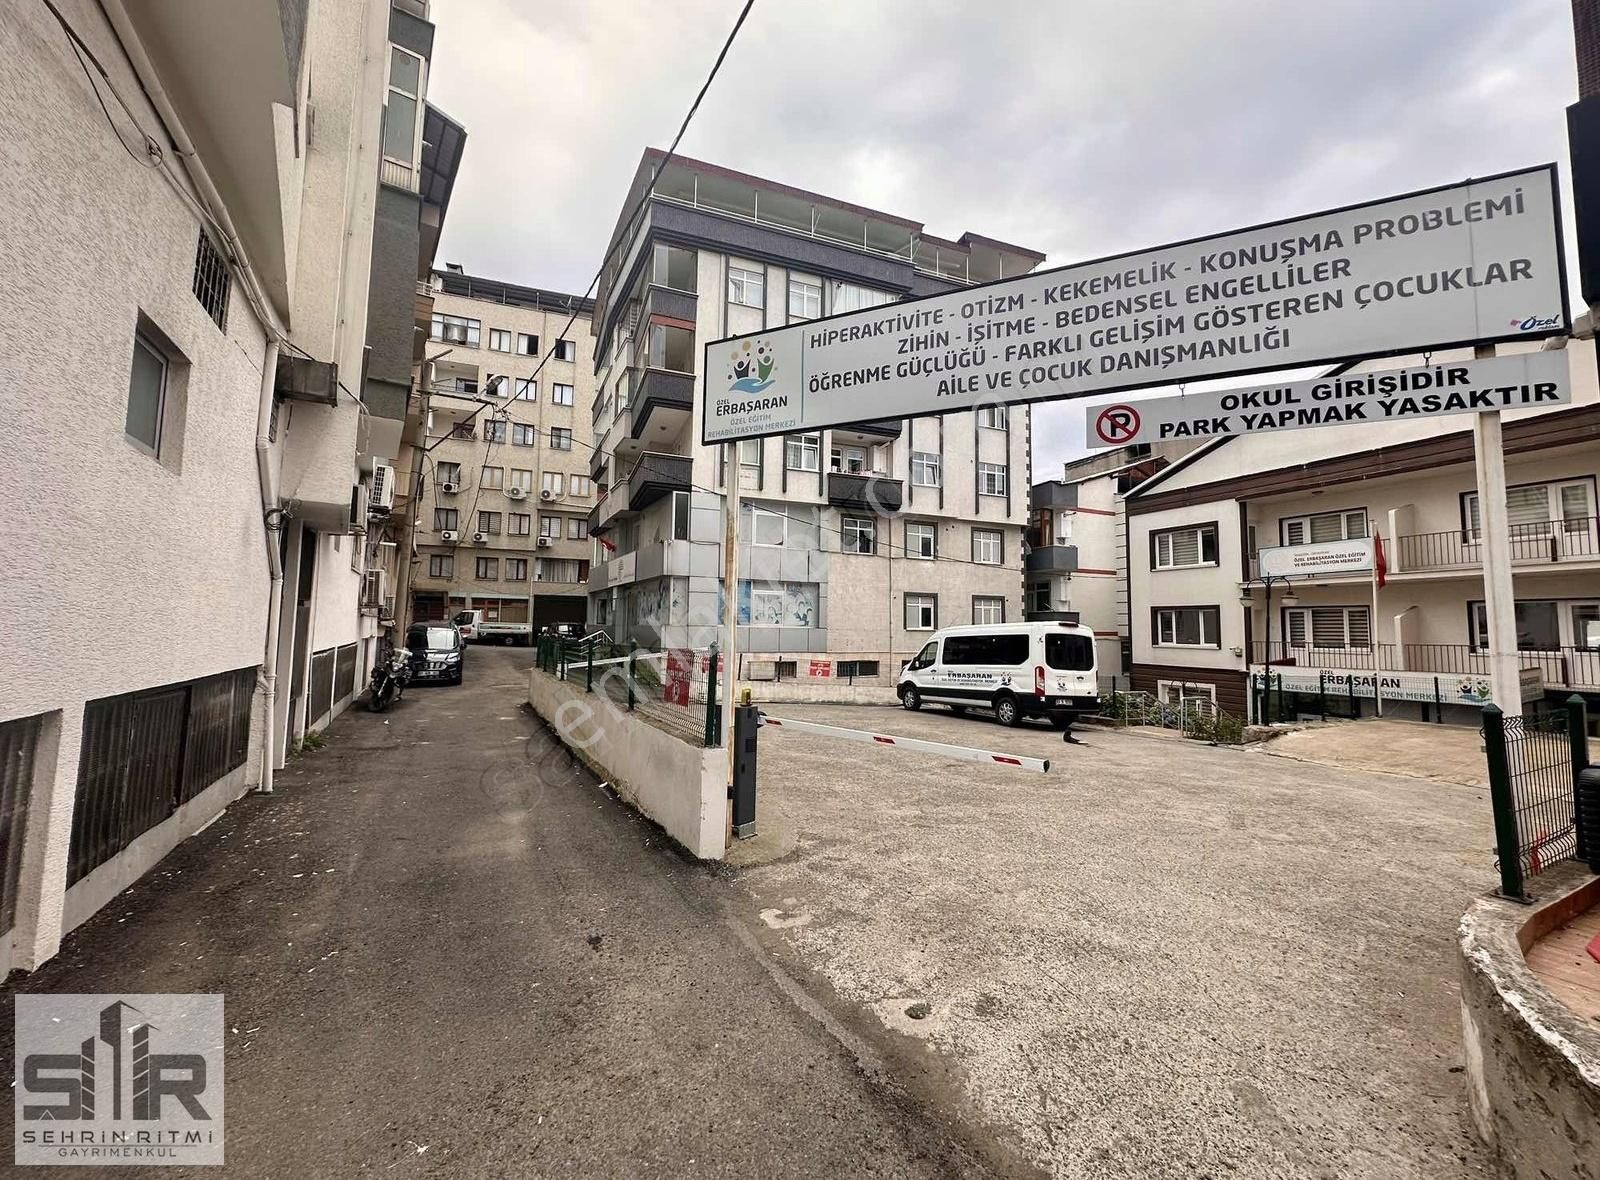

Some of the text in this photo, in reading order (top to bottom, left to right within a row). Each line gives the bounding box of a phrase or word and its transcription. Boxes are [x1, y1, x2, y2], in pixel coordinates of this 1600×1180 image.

[810, 308, 943, 349] HİPERAKTİVİTE
[961, 293, 1024, 319] OTİZM
[1044, 260, 1176, 305] KEKEMELİK
[1200, 229, 1344, 274] KONUŞMA
[1353, 187, 1524, 245] PROBLEMİ
[809, 364, 891, 393] ÖĞRENME
[896, 345, 986, 379] GÜÇLÜĞÜ
[1005, 333, 1082, 362] FARKLI
[1089, 314, 1185, 348] GELİŞİM
[1193, 288, 1343, 331] GÖSTEREN
[1354, 258, 1534, 310] ÇOCUKLAR
[897, 329, 949, 355] ZİHİN
[967, 316, 1036, 346] İŞİTME
[1055, 289, 1177, 329] BEDENSEL
[1185, 257, 1352, 304] ENGELLİLER
[1520, 314, 1560, 331] Özel
[936, 325, 1290, 397] AİLE VE ÇOCUK DANIŞMANLIĞI
[716, 395, 788, 416] ERBAŞARAN
[1160, 382, 1560, 439] PARK YAPMAK YASAKTIR
[1220, 366, 1471, 411] OKUL GİRİŞİDİR
[730, 417, 747, 426] ÖZEL
[1332, 687, 1403, 698] REHBİLİTSYON
